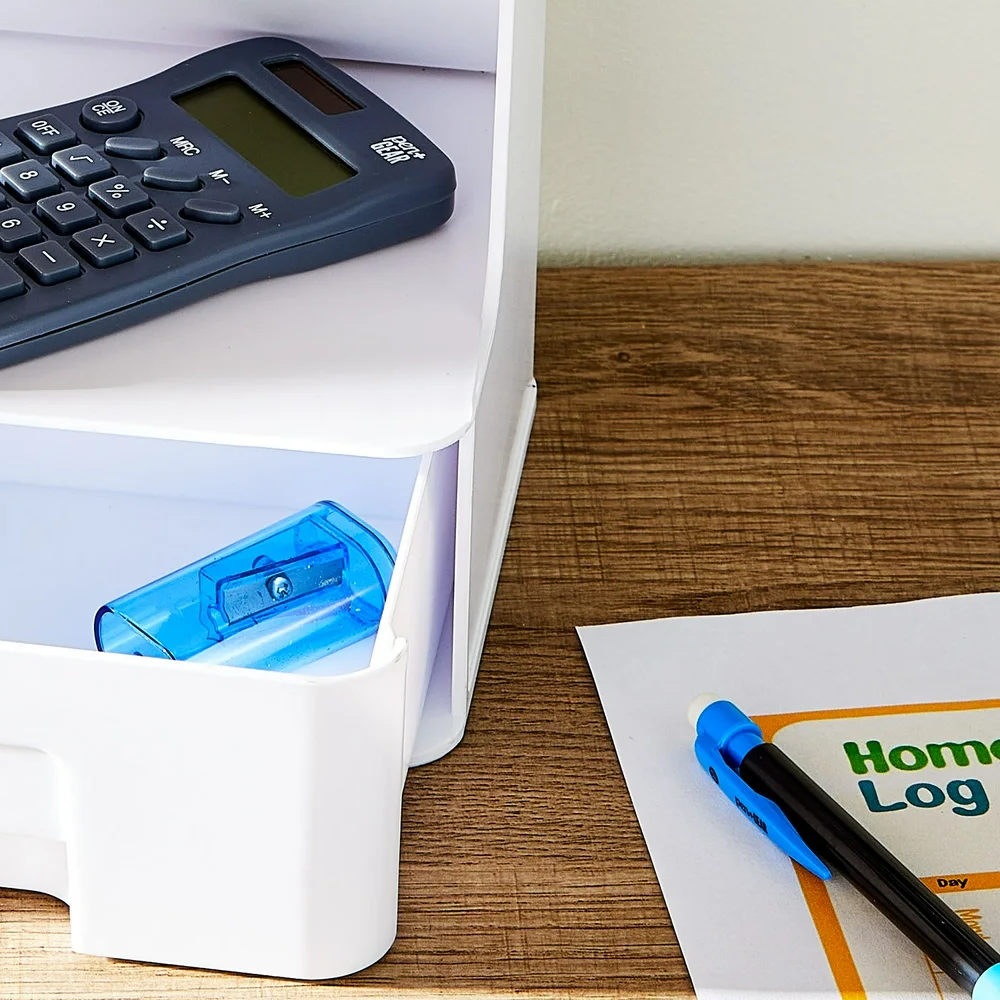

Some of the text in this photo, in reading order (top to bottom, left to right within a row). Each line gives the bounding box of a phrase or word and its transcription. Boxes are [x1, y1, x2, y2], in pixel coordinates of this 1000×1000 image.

[106, 101, 127, 113] ON
[31, 120, 60, 137] OFF
[169, 135, 201, 157] MRC
[370, 141, 411, 165] GEAR
[18, 170, 39, 181] 8
[56, 202, 76, 212] 9
[248, 203, 272, 219] M+
[1, 219, 21, 229] 6
[858, 778, 990, 817] Log
[937, 878, 968, 889] Day
